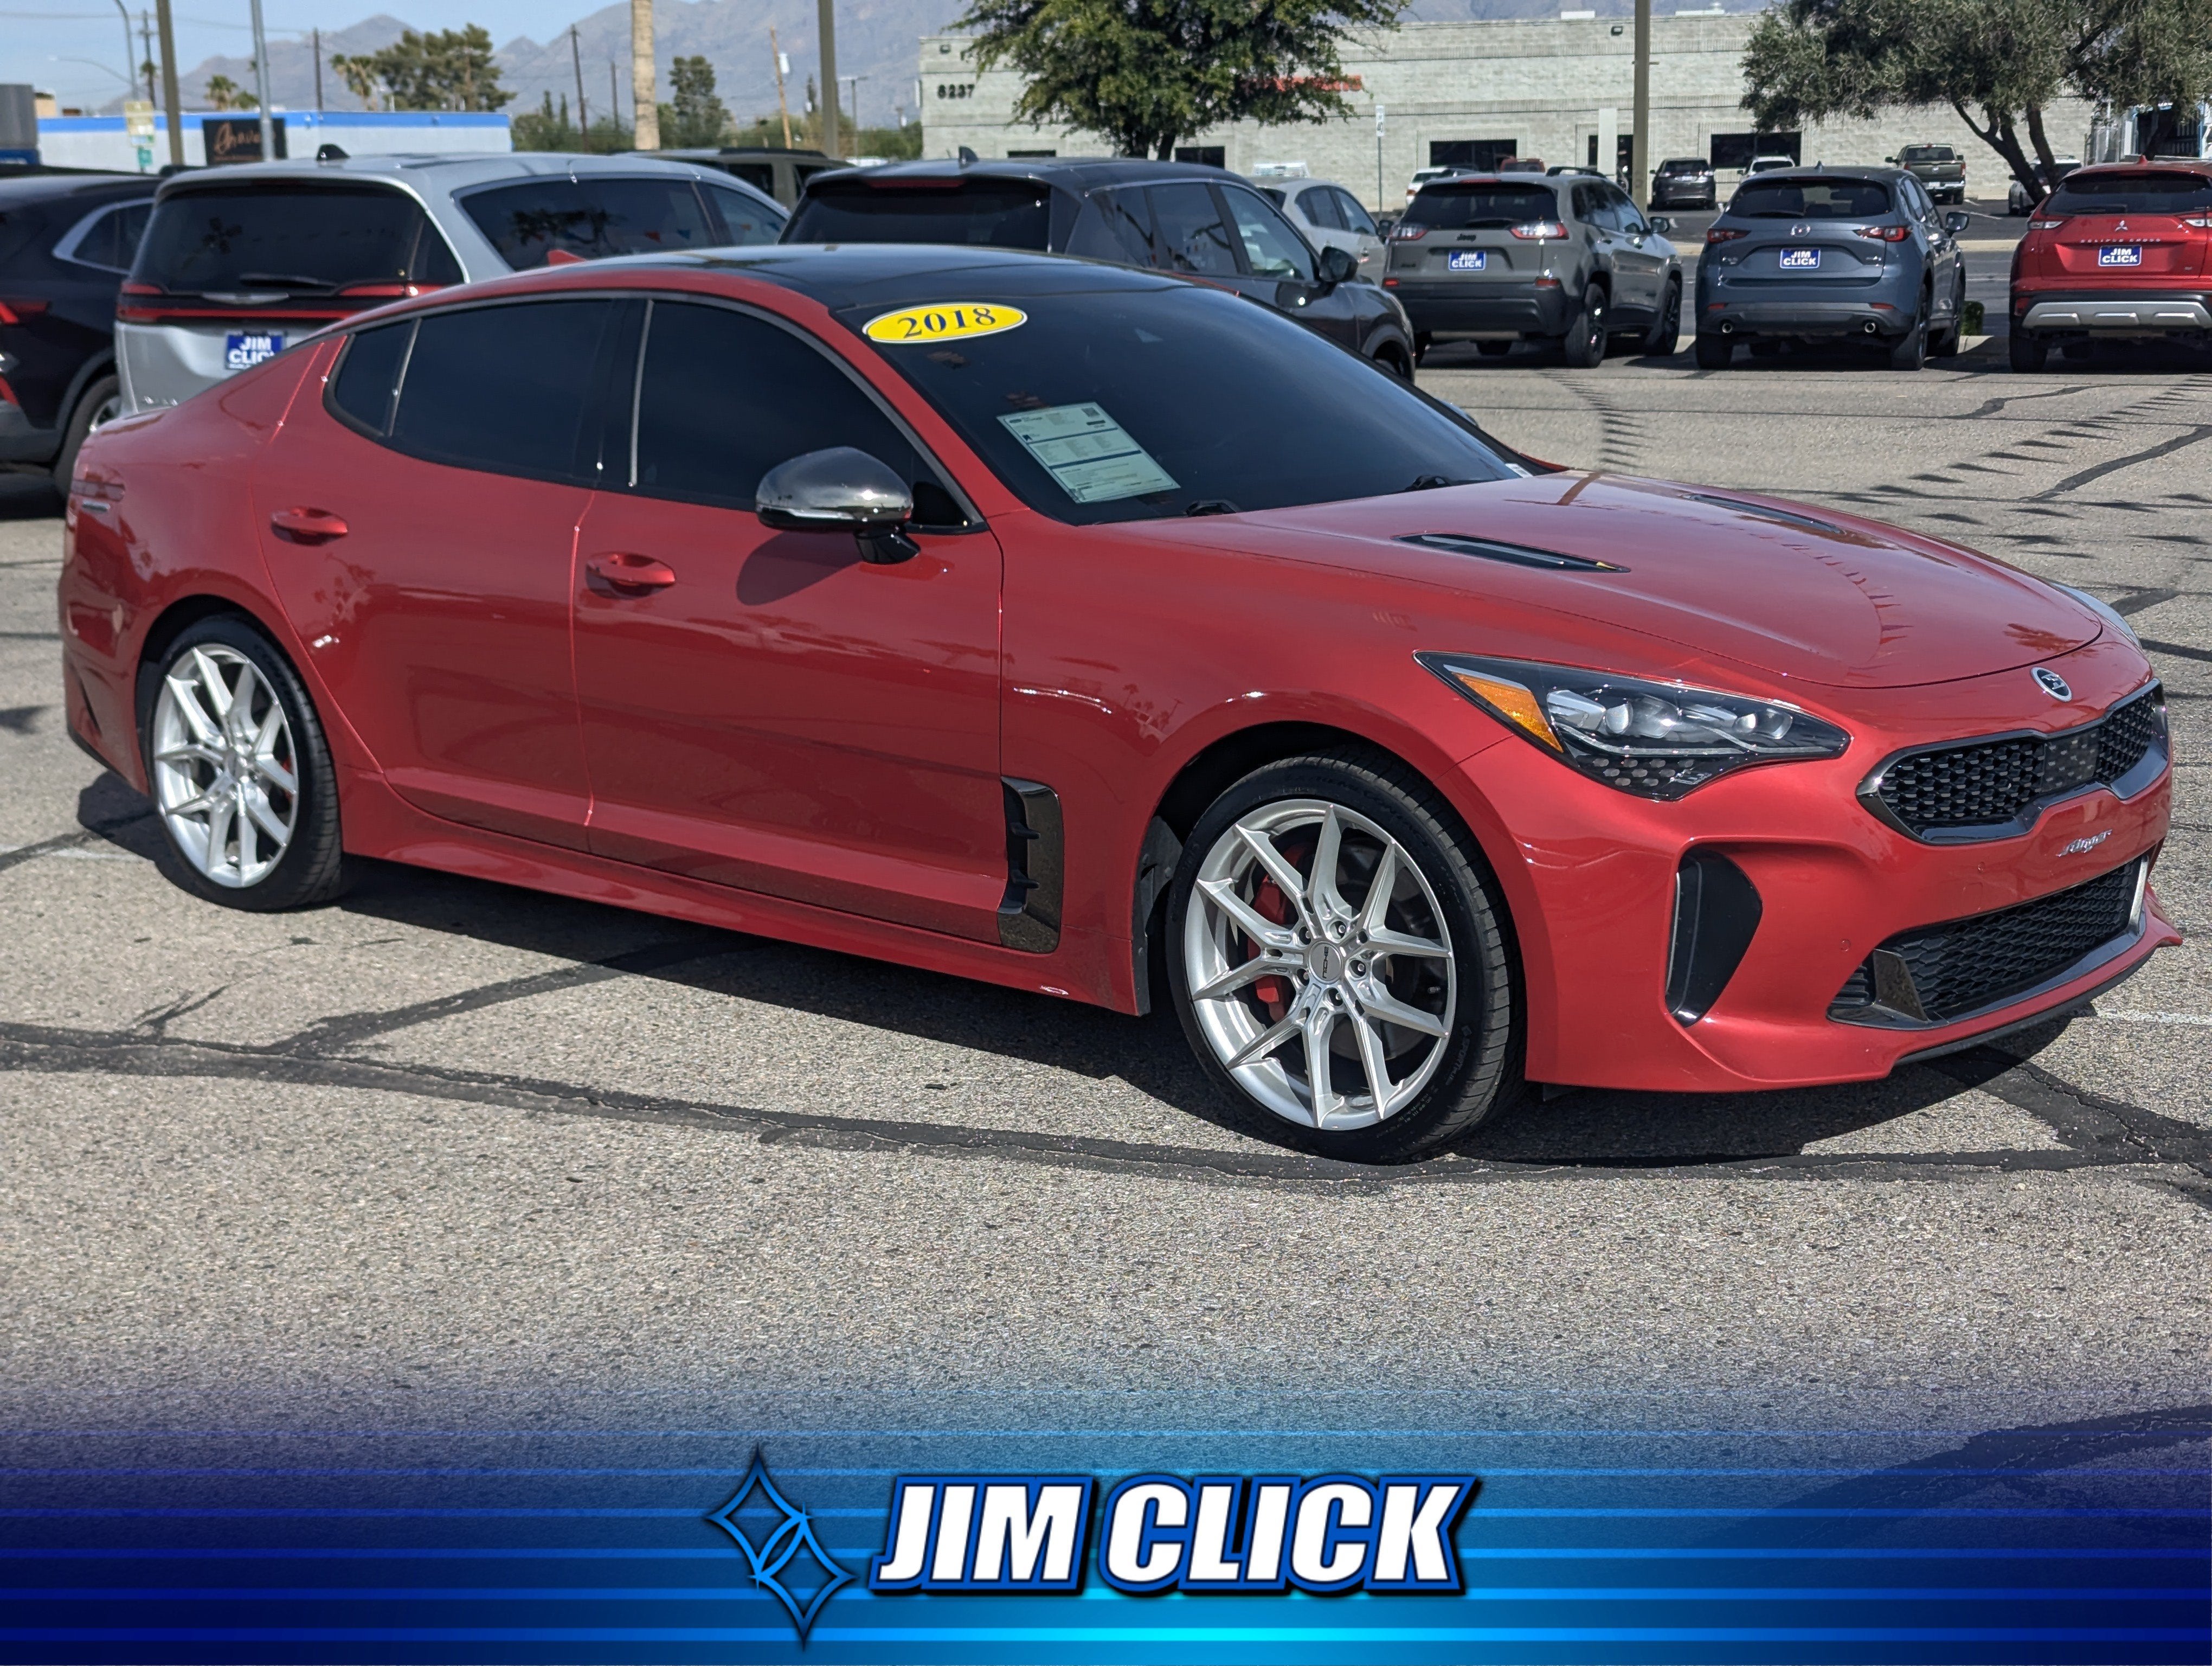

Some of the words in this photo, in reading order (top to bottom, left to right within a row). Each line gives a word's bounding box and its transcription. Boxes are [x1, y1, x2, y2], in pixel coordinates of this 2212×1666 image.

[2110, 247, 2132, 255] JIM
[1783, 258, 1817, 266] CLICK
[2101, 255, 2138, 263] CLICK
[1451, 260, 1483, 268] CLICK
[897, 307, 996, 339] 2018
[239, 336, 272, 350] JIM
[228, 348, 275, 364] CLIC
